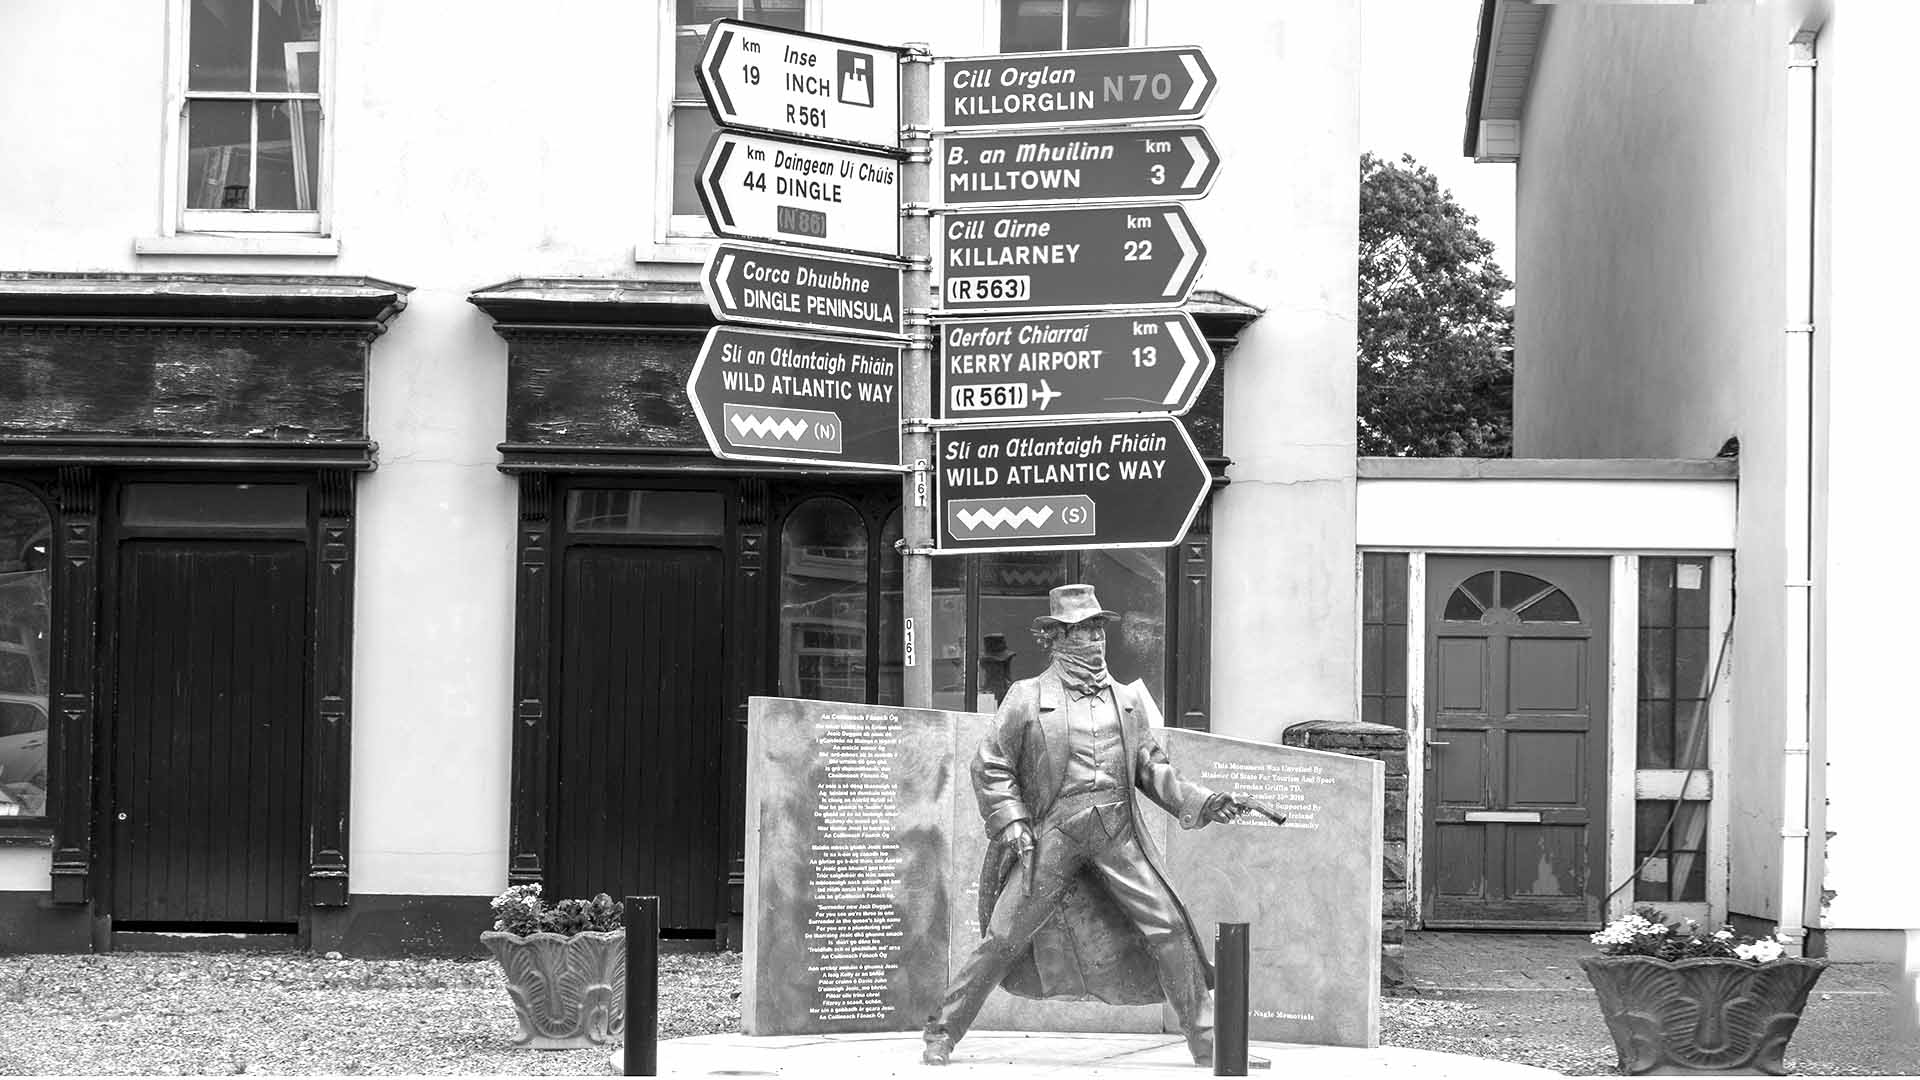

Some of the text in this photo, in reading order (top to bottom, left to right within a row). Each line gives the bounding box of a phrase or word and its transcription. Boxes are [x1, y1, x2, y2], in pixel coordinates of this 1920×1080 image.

[743, 38, 760, 52] km
[784, 45, 816, 66] Inse
[743, 65, 760, 84] 19
[786, 73, 830, 97] INCH
[953, 66, 1075, 89] Cill Orglan
[955, 91, 1094, 115] KILLORGLIN
[747, 146, 765, 160] km
[948, 142, 1114, 164] B. an Mhuilinn
[1146, 140, 1171, 152] km
[775, 151, 833, 176] Daingean
[859, 163, 894, 184] Chúis
[1151, 165, 1165, 184] 3
[744, 171, 766, 192] 44
[777, 177, 842, 202] DINGLE
[951, 169, 1080, 191] MILLTOWN
[948, 220, 1050, 239] Cill Airne
[1127, 215, 1151, 228] km
[951, 245, 1080, 266] KILLARNEY
[1124, 241, 1152, 260] 22
[743, 261, 789, 284] Corca
[744, 289, 893, 322] DINGLE PENINSULA
[950, 325, 1089, 348] Aerfort Chiarraí
[1133, 322, 1158, 335] km
[721, 344, 894, 376] Slí an Atlantaigh Fhiáin
[951, 350, 1102, 374] KERRY AIRPORT
[1133, 347, 1156, 367] 13
[723, 371, 893, 402] WILD ATLANTIC WAY
[814, 423, 835, 440] (N)
[945, 434, 1167, 460] Slí an Atlantaigh Fhiáin
[947, 461, 1166, 486] WILD ATLANTIC WAY
[1062, 506, 1087, 524] (S)
[1230, 763, 1264, 771] Monument
